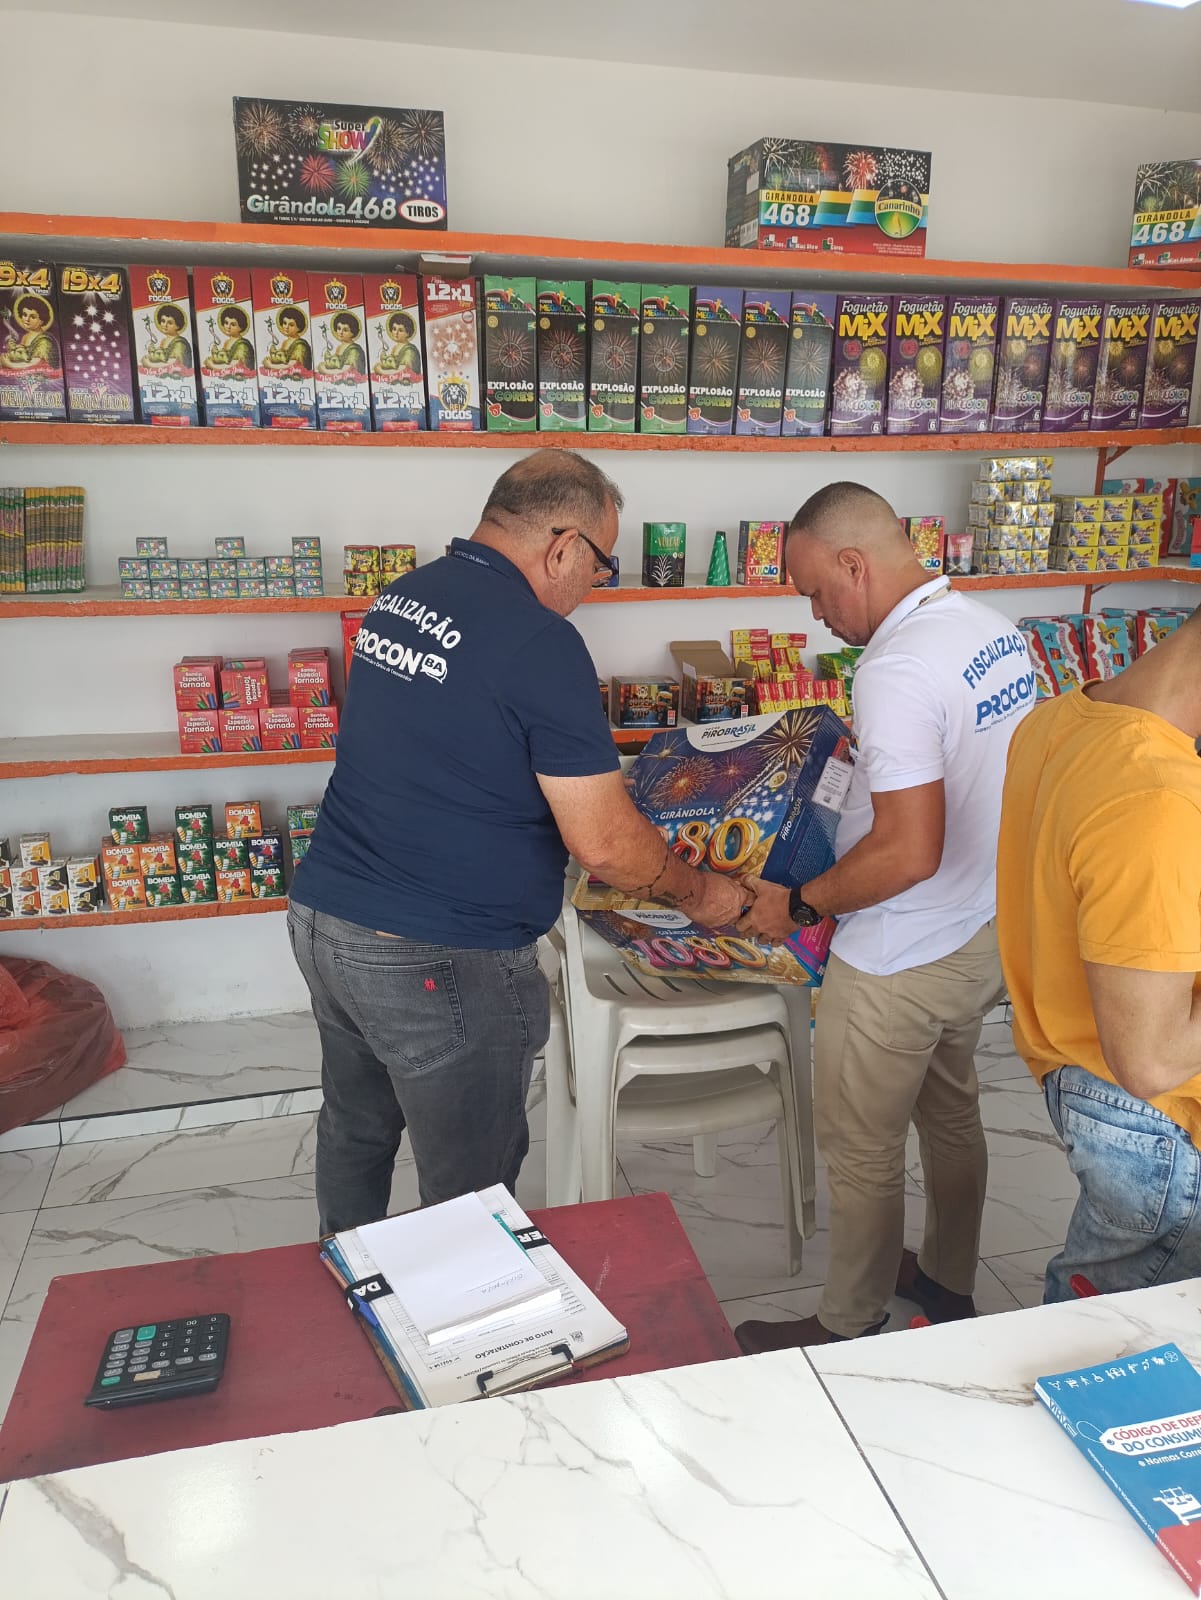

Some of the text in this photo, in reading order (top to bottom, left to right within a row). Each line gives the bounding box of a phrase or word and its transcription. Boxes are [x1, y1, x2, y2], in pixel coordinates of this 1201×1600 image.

[333, 120, 366, 132] Super
[318, 124, 368, 150] SHOW
[765, 191, 814, 203] GIRANDOLA
[247, 194, 397, 220] Girândola 468
[406, 204, 439, 218] TIROS
[878, 201, 921, 216] Canarinho
[764, 203, 810, 226] 468
[1136, 211, 1191, 223] GIRANDOLA
[1135, 221, 1186, 244] 468
[0, 265, 49, 290] 9x4
[63, 270, 119, 293] 19x4
[427, 283, 473, 302] 12x1
[841, 300, 888, 314] Foguetão
[898, 300, 944, 313] Foguetão
[953, 302, 997, 315] Foguetão
[1009, 302, 1052, 316] Foguetão
[1059, 304, 1102, 316] Foguetão
[1109, 304, 1150, 316] Foguetão
[1157, 303, 1200, 316] Foguetão
[488, 380, 534, 390] EXPLOSÃO
[540, 381, 584, 390] EXPLOSÃO
[591, 383, 635, 392] EXPLOSÃO
[642, 384, 686, 394] EXPLOSÃO
[690, 386, 733, 396] EXPLOSÃO
[739, 387, 781, 397] EXPLOSÃO
[785, 388, 825, 397] EXPLOSÃO
[438, 410, 472, 420] FOGOS
[369, 594, 461, 649] ISCALIZAÇÃO
[425, 658, 443, 672] BA
[962, 632, 1025, 690] FISCALIZAÇ
[244, 676, 252, 705] Tornado
[976, 670, 1035, 726] PROCON
[112, 814, 141, 822] BOMBA
[178, 811, 207, 820] BOMBA
[228, 808, 256, 816] BOMBA
[660, 807, 714, 820] GIRÂNDOLA
[179, 842, 208, 850] BOMBA
[216, 840, 244, 848] BOMBA
[251, 838, 278, 846] BOMBA
[668, 817, 760, 872] 80
[105, 847, 134, 856] BOMBA
[142, 845, 170, 854] BOMBA
[183, 873, 211, 881] BOMBA
[219, 871, 247, 879] BOMBA
[253, 867, 281, 876] BOMBA
[111, 878, 141, 887] BOMBA
[147, 876, 176, 884] BOMBA
[632, 936, 767, 968] 1080
[516, 1230, 545, 1243] ER
[534, 1329, 553, 1339] AUTO
[475, 1340, 524, 1359] CONSTATAÇÃO
[1113, 1424, 1162, 1441] CÓDIGO
[1161, 1420, 1180, 1431] DE
[1121, 1427, 1201, 1452] DO CONSUMI
[1144, 1454, 1180, 1466] Normas
